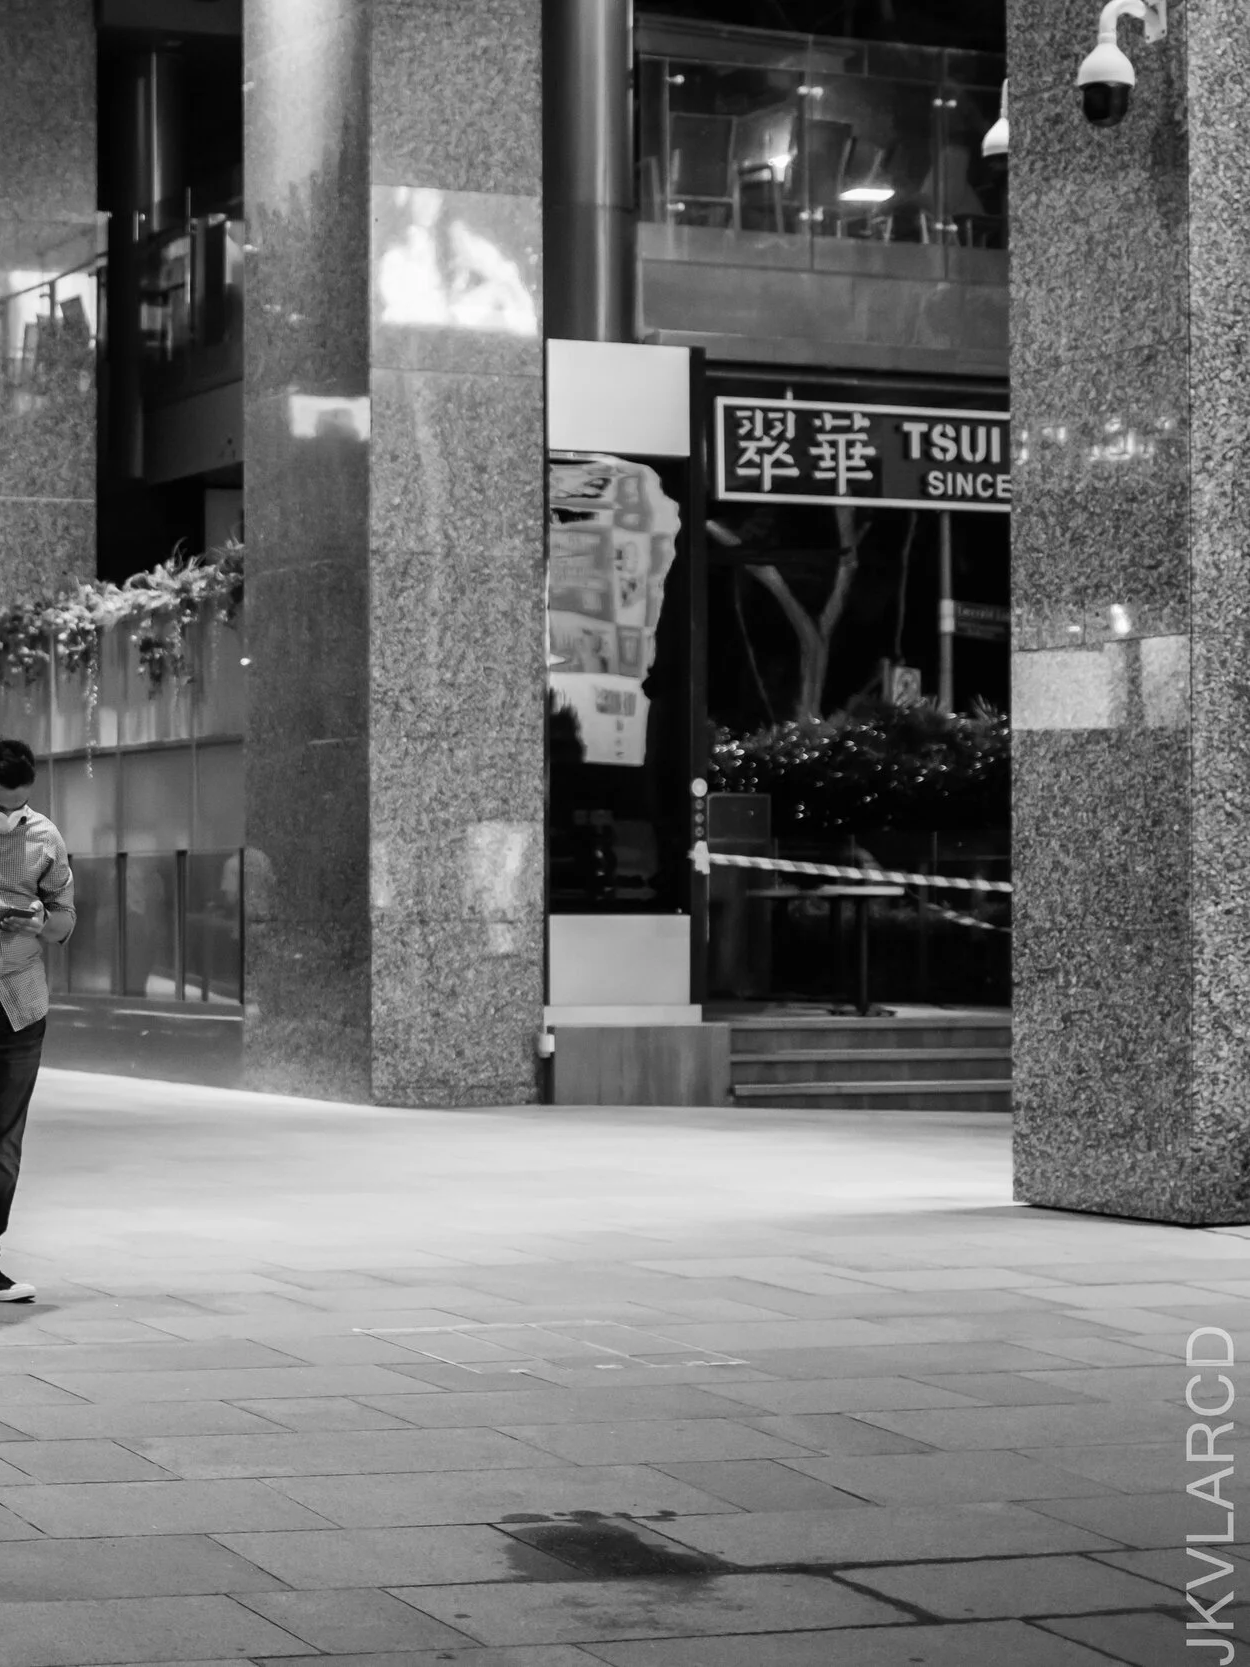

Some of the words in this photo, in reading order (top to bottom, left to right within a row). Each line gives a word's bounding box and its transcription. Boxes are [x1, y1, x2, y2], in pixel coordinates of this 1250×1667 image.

[734, 408, 877, 497] 翠華
[902, 421, 1001, 464] TSUI
[927, 470, 1010, 498] SINCE
